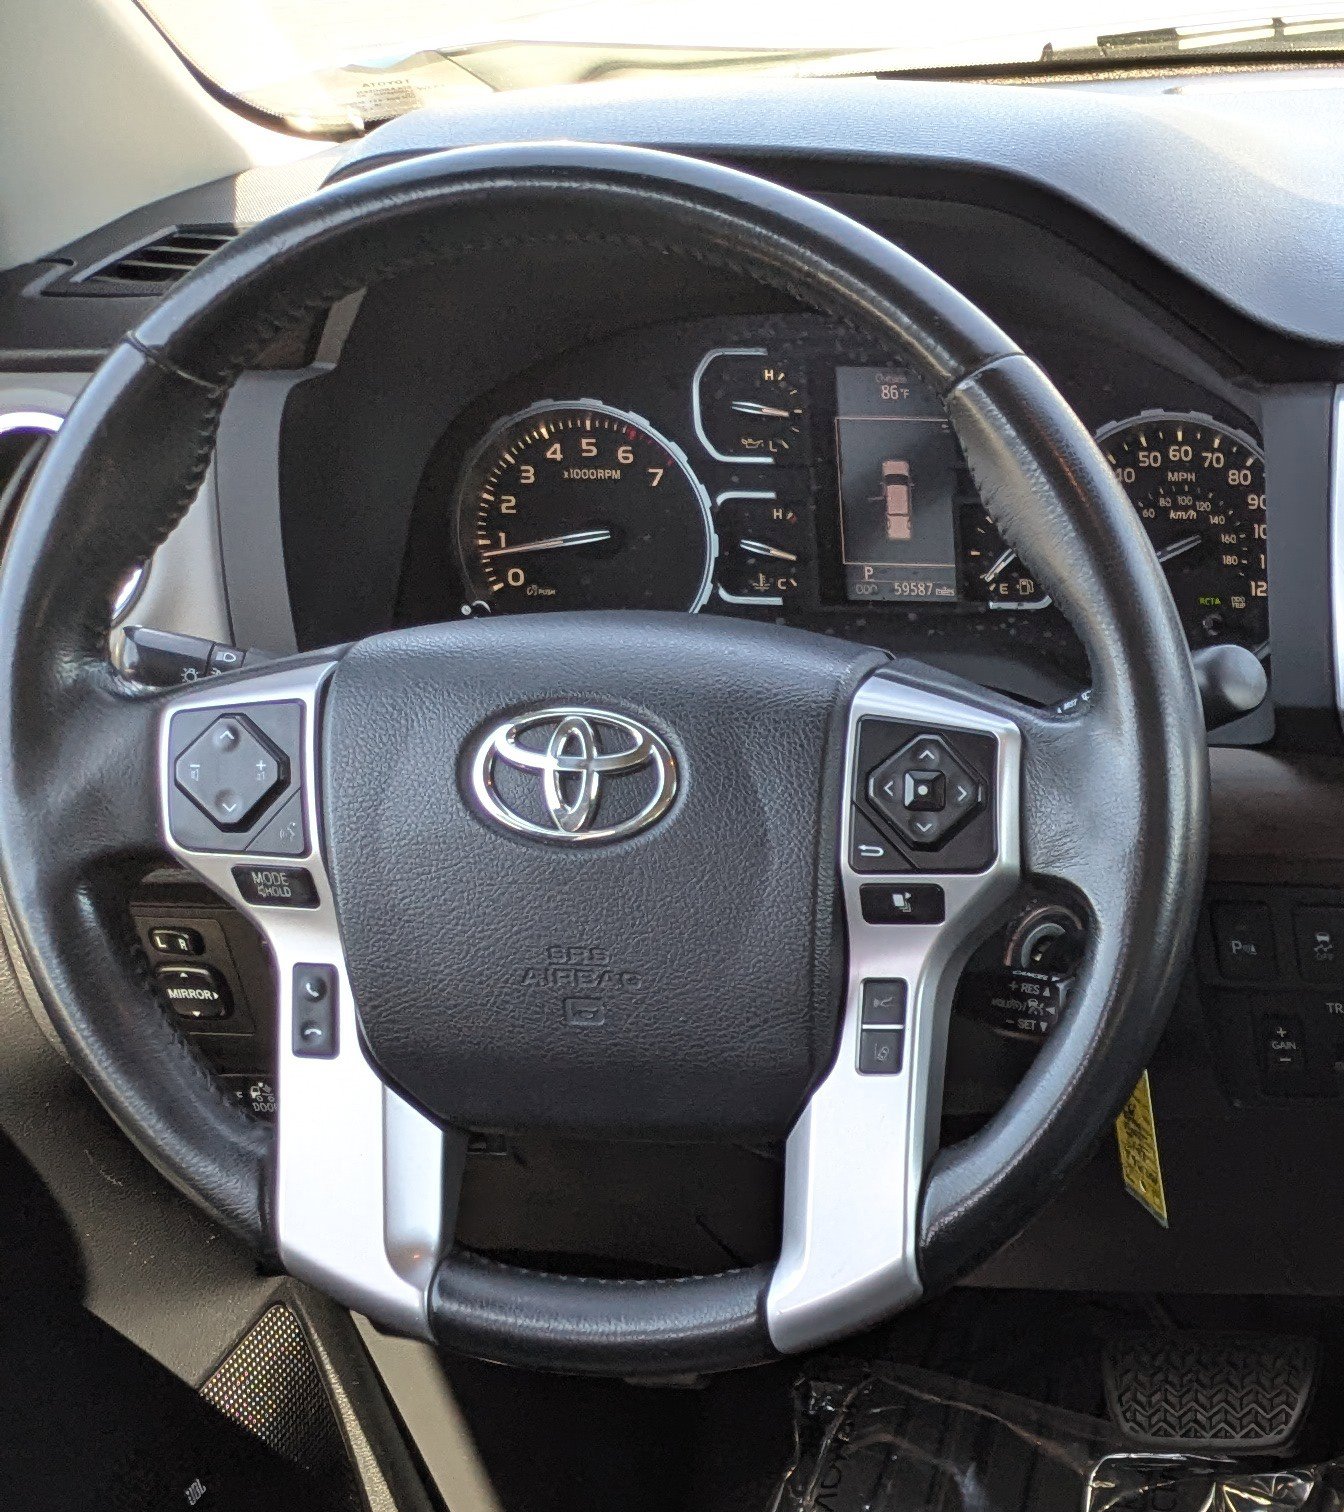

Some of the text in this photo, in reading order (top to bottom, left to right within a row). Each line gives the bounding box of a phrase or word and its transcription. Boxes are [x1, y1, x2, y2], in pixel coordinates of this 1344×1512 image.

[764, 370, 774, 381] H
[546, 443, 563, 462] 4
[581, 438, 598, 457] 5
[769, 441, 778, 452] L
[617, 446, 634, 464] 6
[1138, 452, 1162, 467] 50
[1168, 446, 1192, 461] 60
[1201, 453, 1225, 468] 70
[520, 465, 535, 484] 3
[648, 468, 664, 487] 7
[1167, 472, 1196, 483] MPH
[1227, 470, 1252, 486] 80
[501, 495, 517, 514] 2
[1176, 495, 1193, 506] 100
[1196, 502, 1212, 512] 120
[773, 509, 783, 520] H
[1142, 508, 1155, 519] 60
[1169, 509, 1197, 521] km/h
[1208, 514, 1226, 525] 140
[499, 532, 507, 549] 1
[1220, 533, 1237, 544] 160
[1222, 555, 1239, 565] 180
[507, 568, 525, 587] 0
[864, 566, 874, 580] P
[777, 579, 787, 590] C
[894, 583, 933, 596] 59587
[1000, 584, 1009, 594] E
[1250, 581, 1267, 597] 12
[251, 871, 290, 886] MODE
[265, 886, 292, 898] HOLD
[155, 936, 167, 949] L
[167, 988, 212, 1000] MIRROR
[1017, 1018, 1037, 1030] SET
[1271, 1040, 1297, 1050] GAIN
